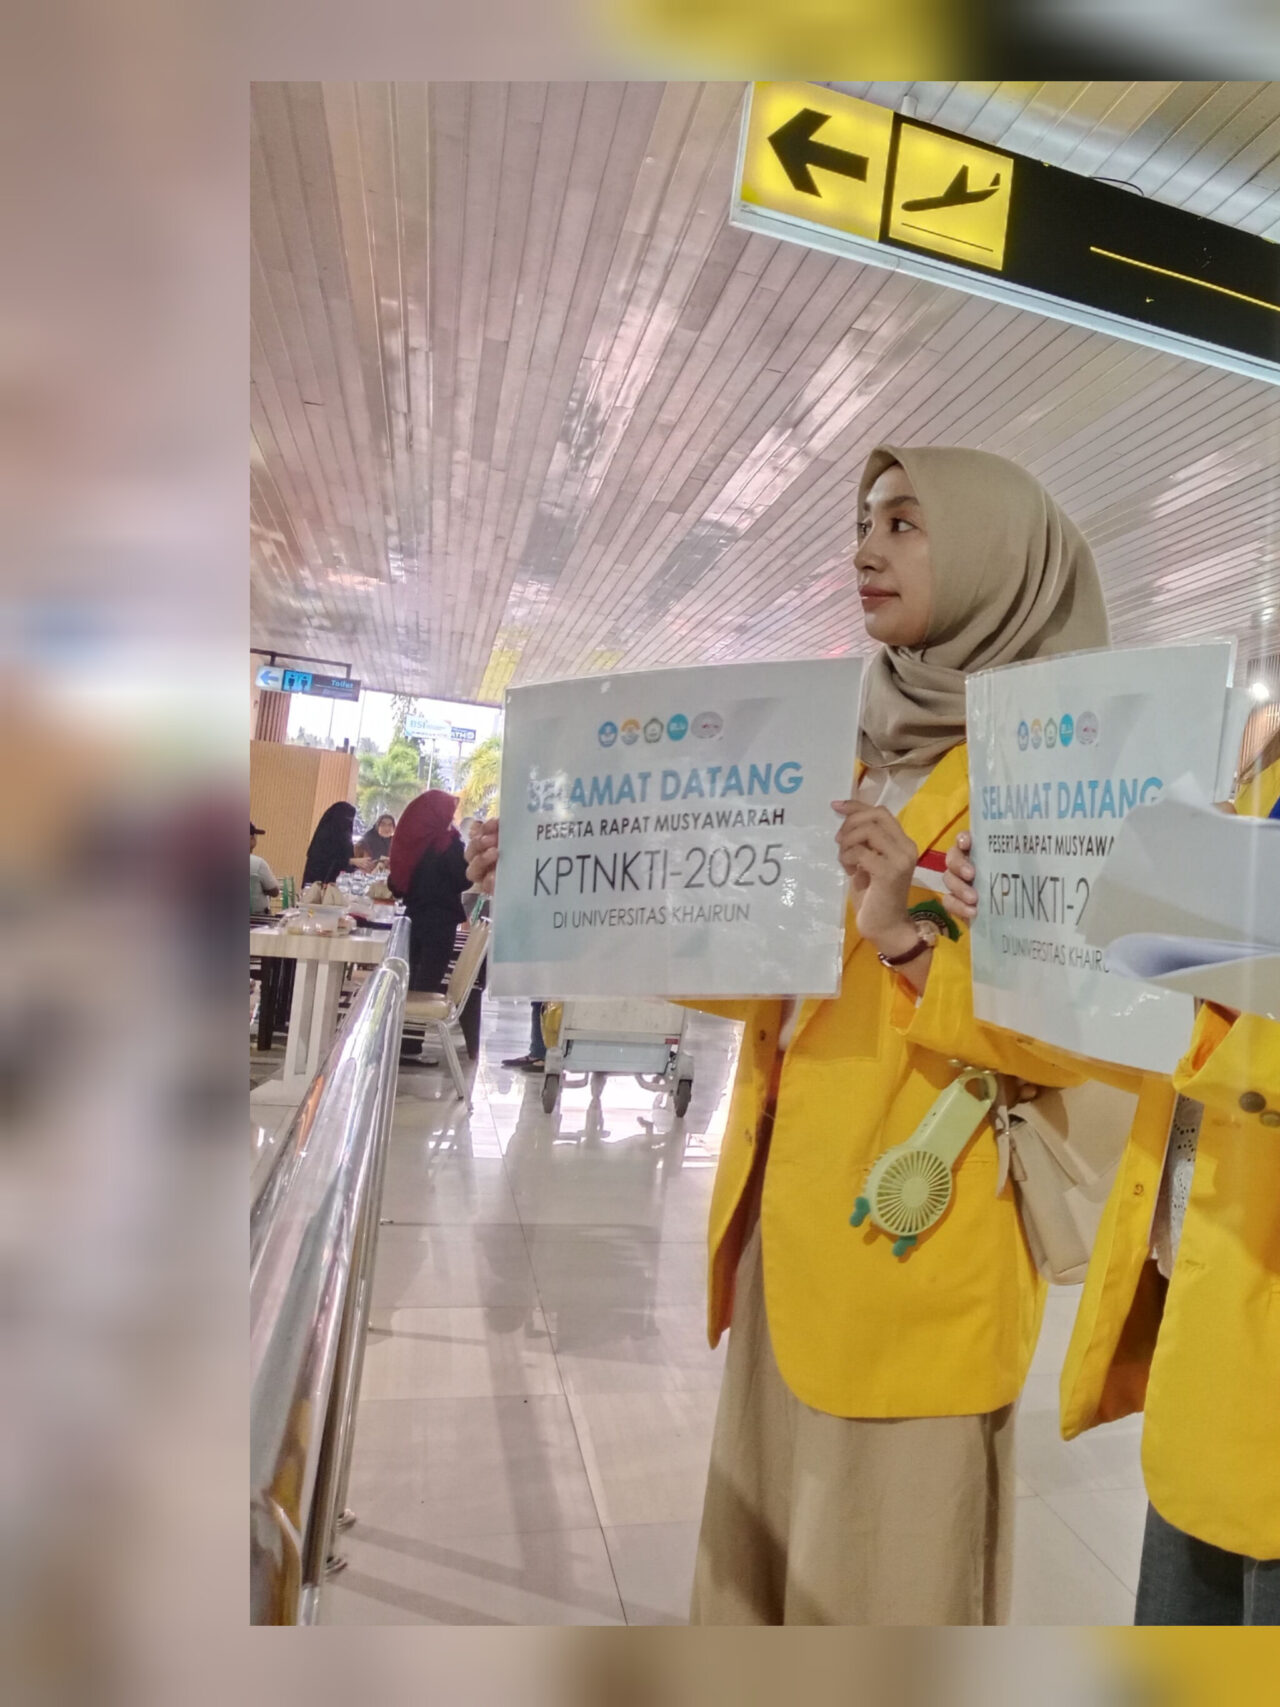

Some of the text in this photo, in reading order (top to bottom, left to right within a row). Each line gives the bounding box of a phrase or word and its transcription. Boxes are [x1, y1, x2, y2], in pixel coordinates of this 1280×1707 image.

[661, 761, 804, 801] DATANG
[982, 783, 1052, 820] SELAMAT
[536, 808, 785, 841] PESERTA RAPAT MUSYAWARAH
[988, 835, 1020, 855] PESERTA
[1022, 835, 1053, 855] RAPAT
[533, 843, 784, 896] KPTNKTI-2025
[553, 903, 750, 929] DI UNIVERSITAS KHAIRUN
[989, 872, 1091, 926] KPTNKTI-2
